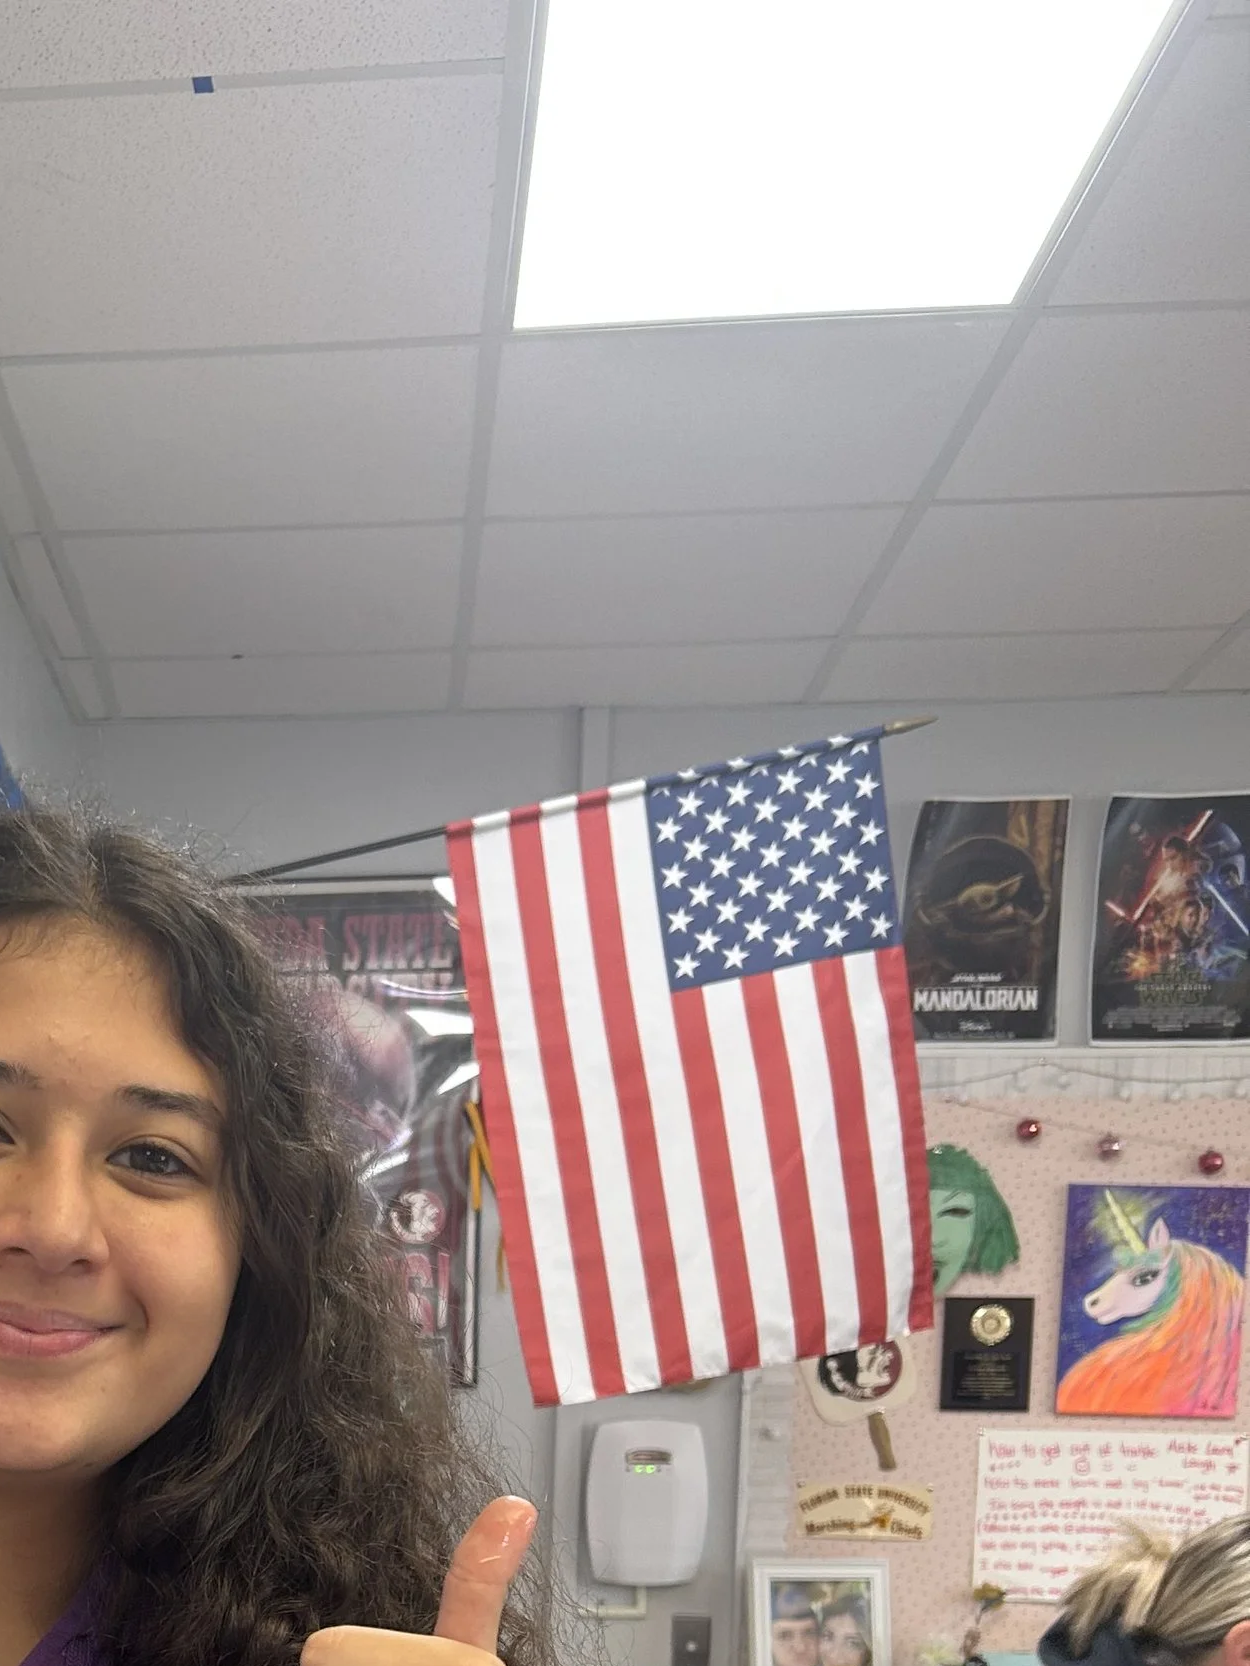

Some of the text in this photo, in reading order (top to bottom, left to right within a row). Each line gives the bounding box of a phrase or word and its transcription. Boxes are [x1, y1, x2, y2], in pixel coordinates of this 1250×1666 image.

[342, 914, 453, 972] STATE
[913, 987, 1039, 1012] MANDALORIAN
[844, 1484, 874, 1499] STATE
